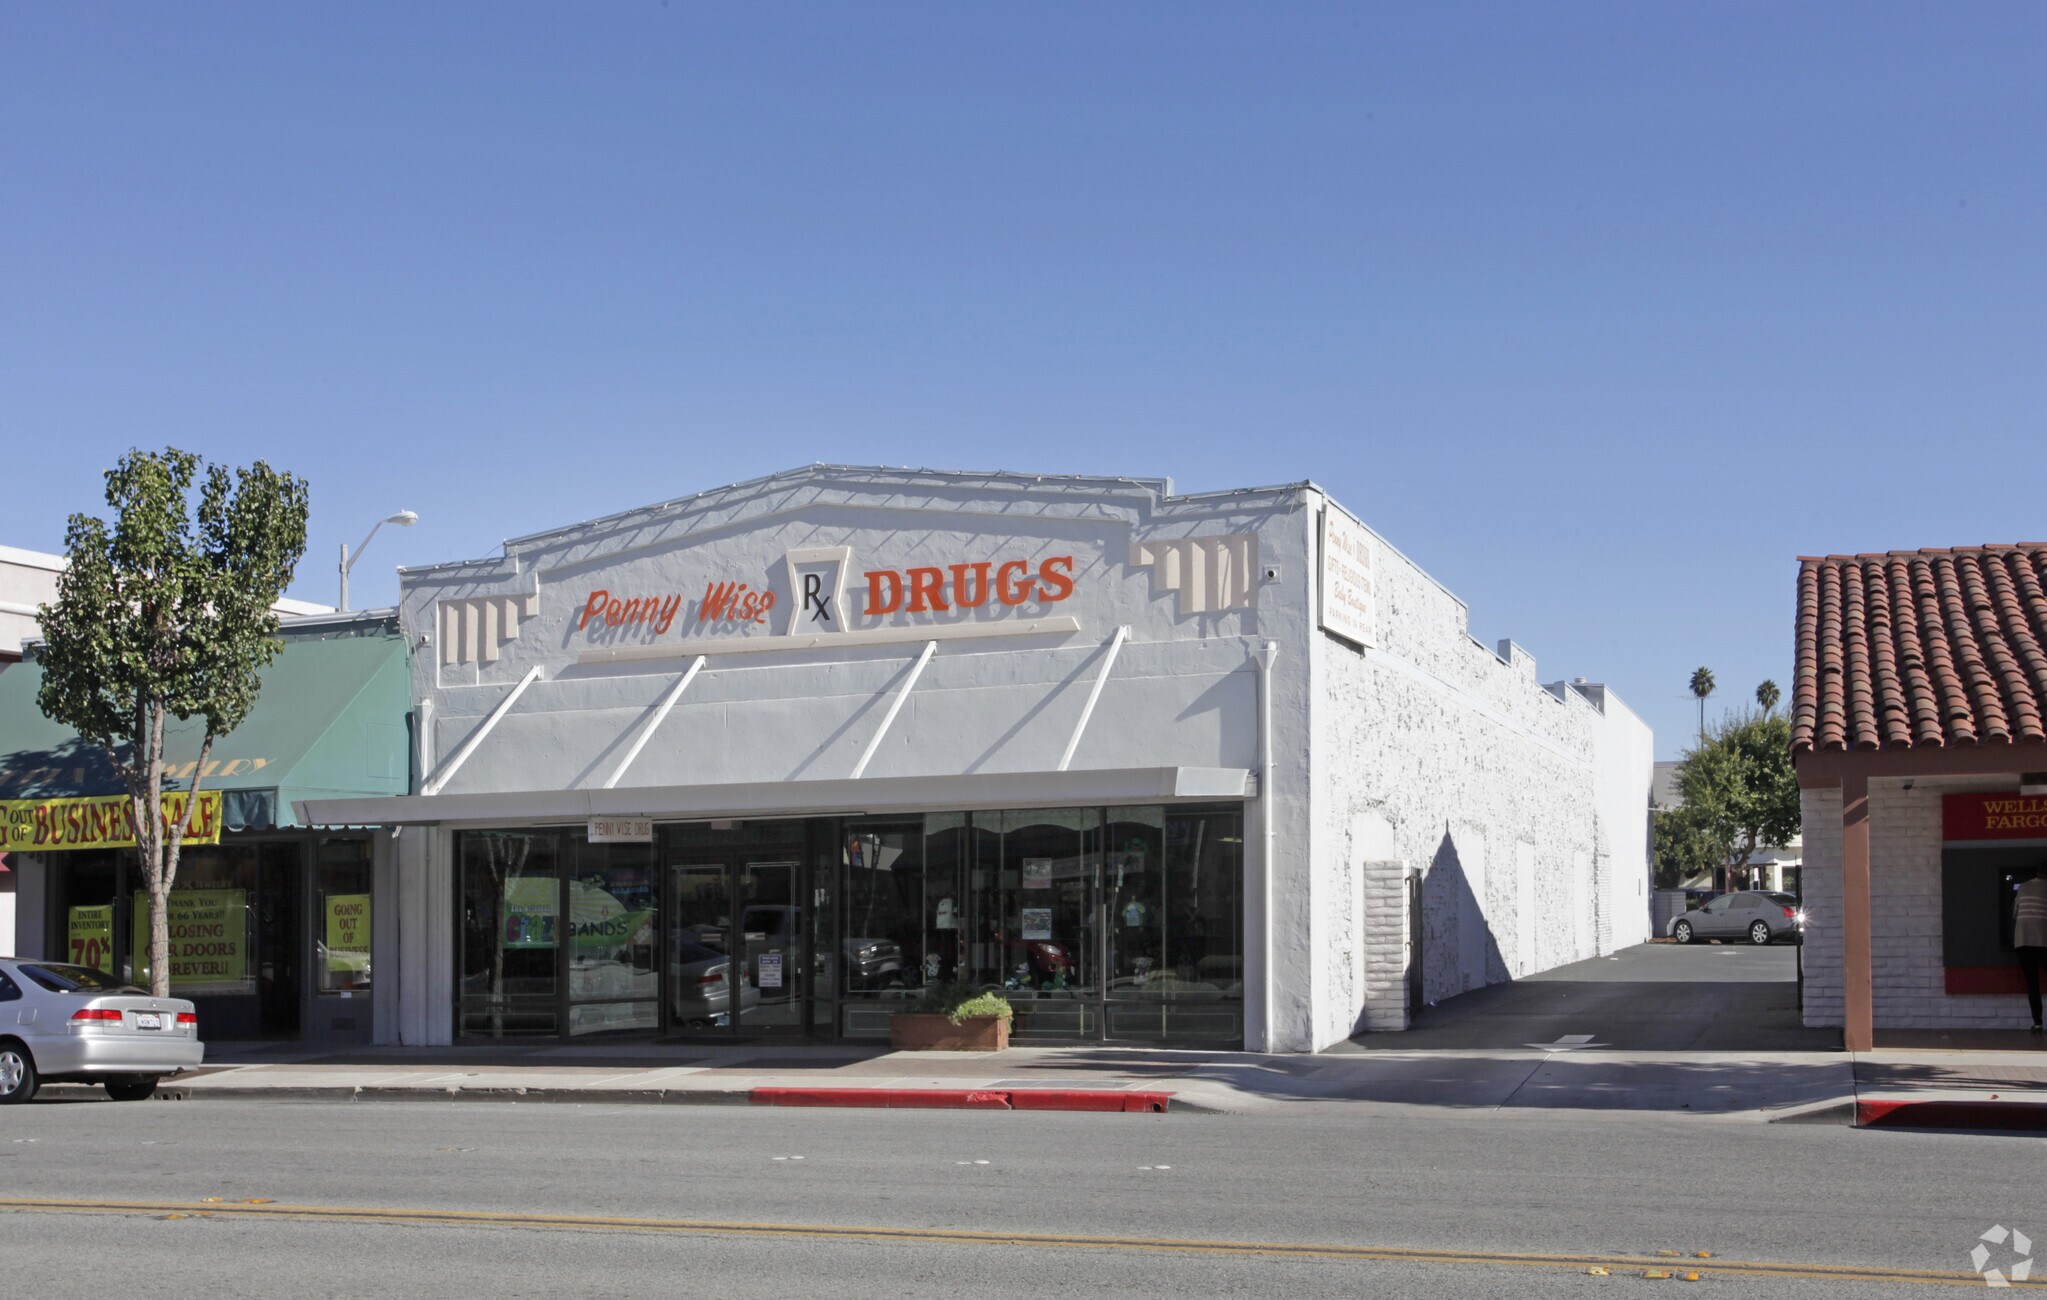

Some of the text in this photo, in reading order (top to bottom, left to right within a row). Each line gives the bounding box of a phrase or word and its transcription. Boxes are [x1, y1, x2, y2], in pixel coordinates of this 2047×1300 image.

[863, 556, 1074, 615] DRUGS
[579, 581, 776, 635] Penny Wise
[10, 809, 35, 825] OUT
[32, 799, 149, 846] BUSINES
[11, 826, 28, 842] OF
[78, 910, 102, 919] ENTIRE
[177, 912, 190, 920] 66
[334, 903, 363, 916] GOING
[71, 920, 110, 930] INVENTORY
[168, 924, 225, 939] LOSING
[339, 918, 358, 930] OUT
[569, 921, 628, 937] BANDS
[343, 932, 354, 944] OF
[183, 942, 236, 957] DOORS
[168, 961, 229, 977] REVER!!
